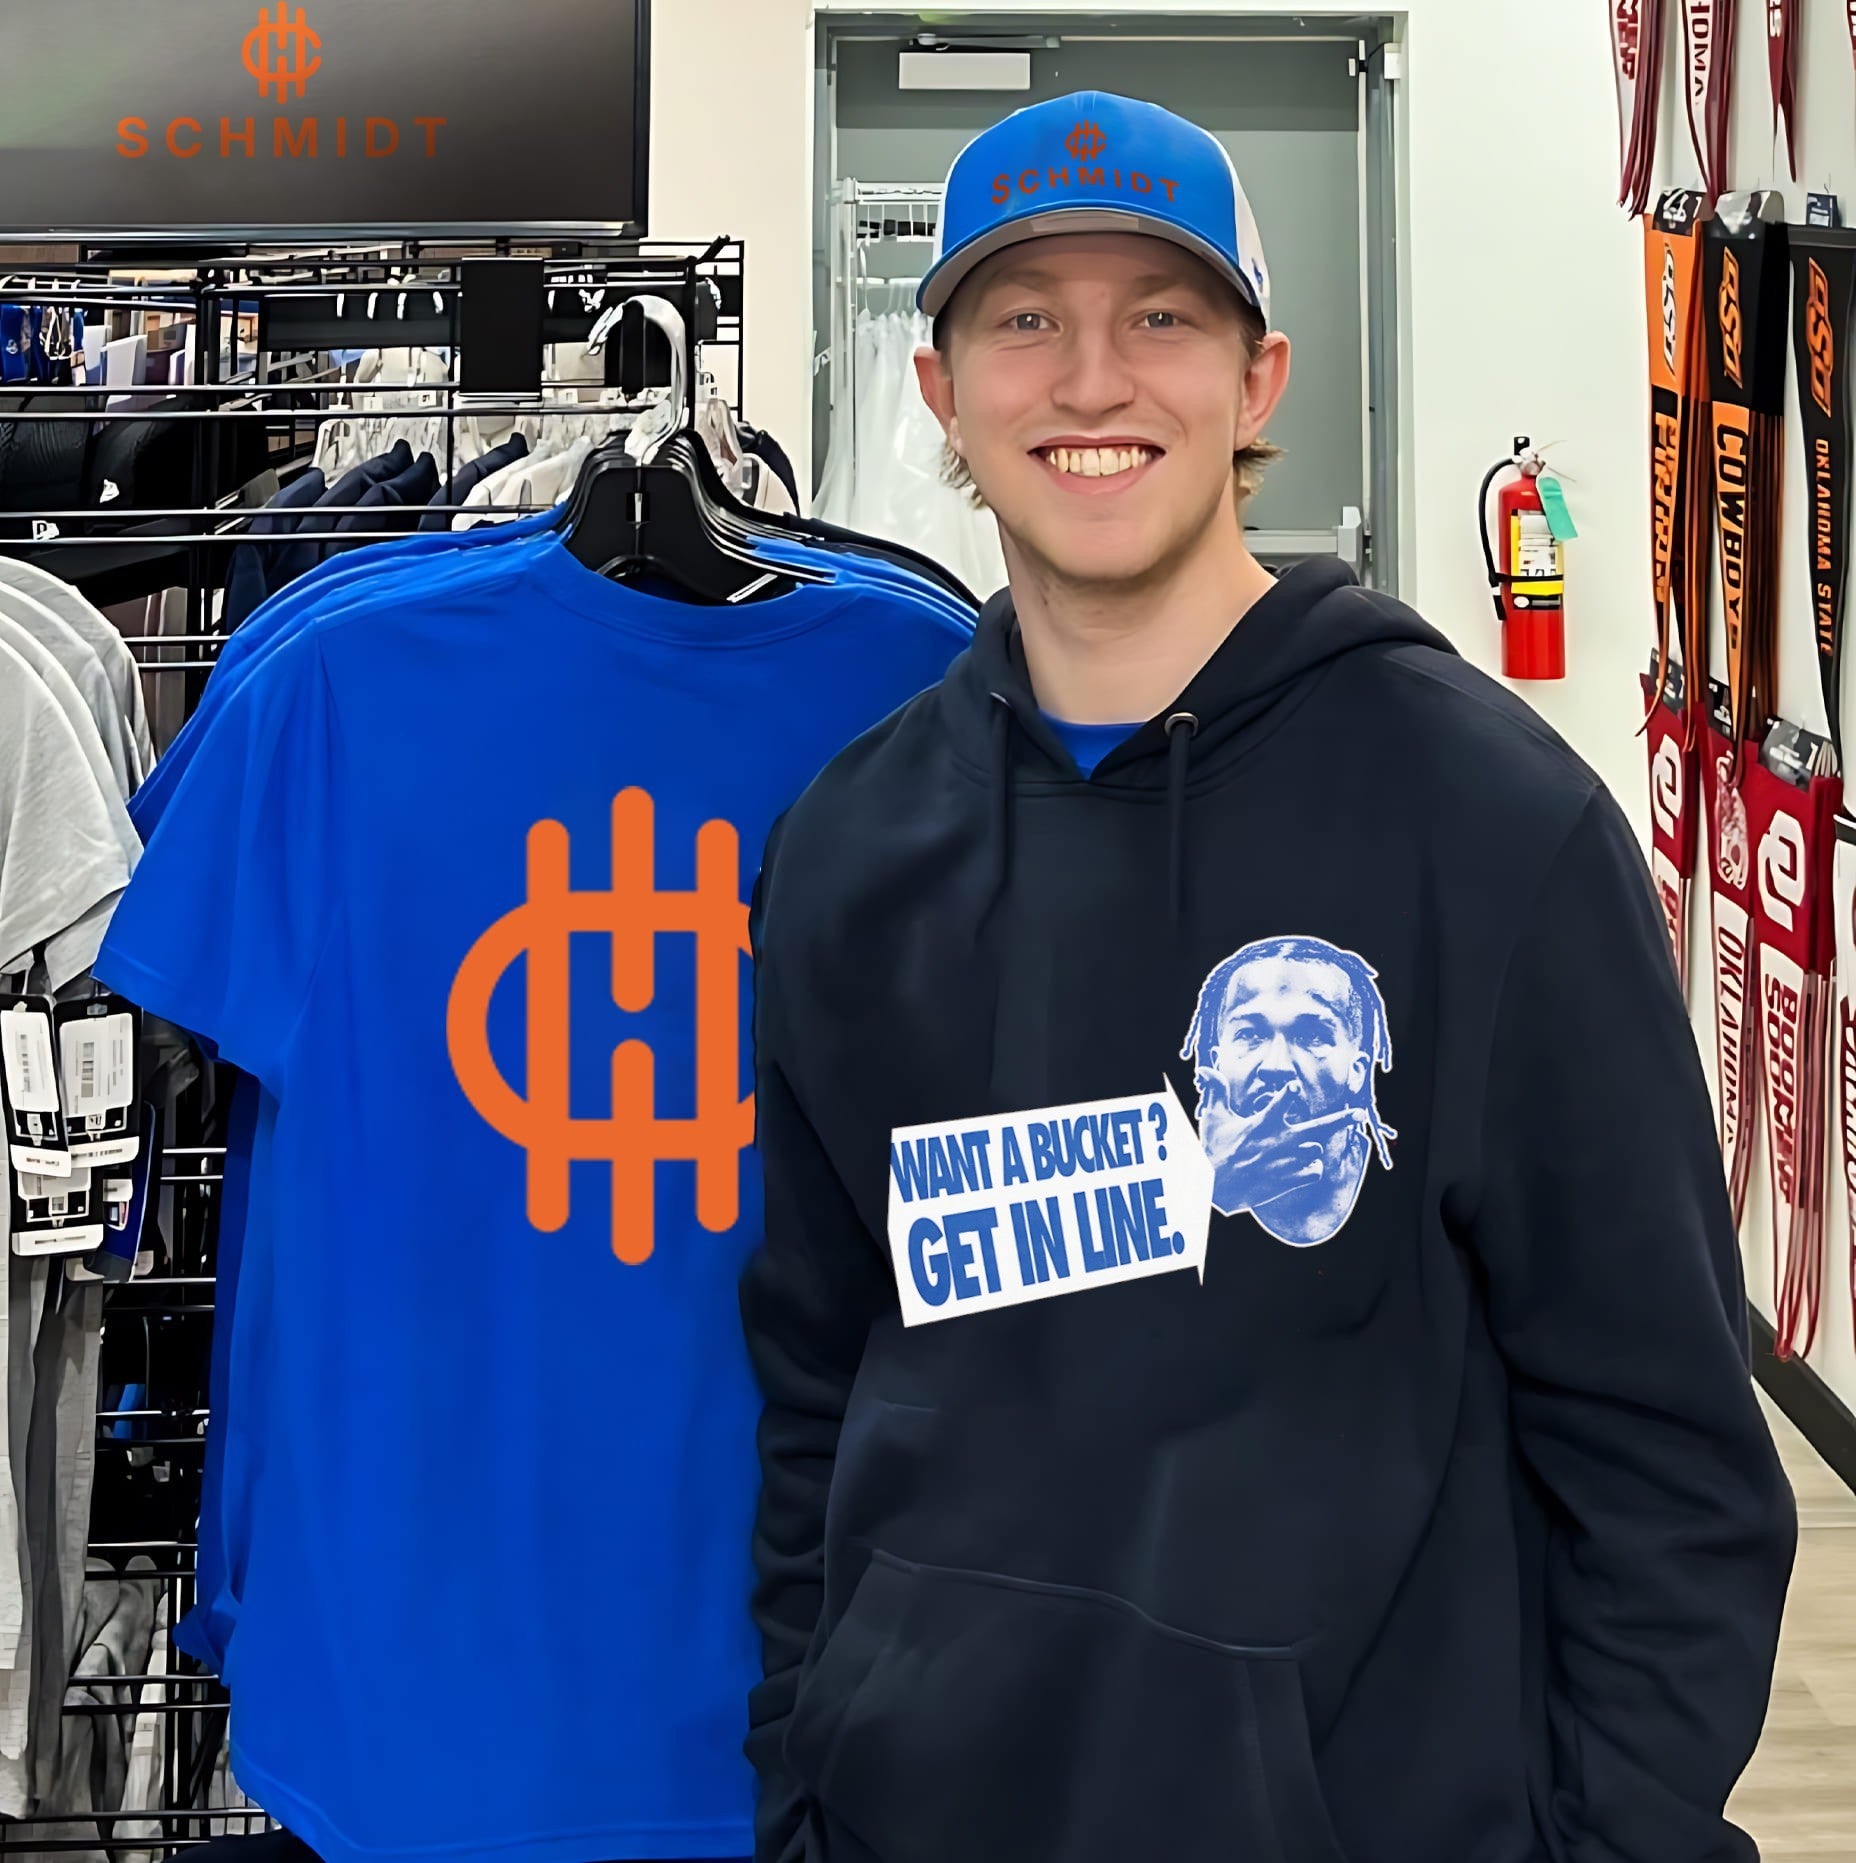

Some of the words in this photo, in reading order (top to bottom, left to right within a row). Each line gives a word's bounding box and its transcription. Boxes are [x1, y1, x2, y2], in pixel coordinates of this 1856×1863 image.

[115, 117, 447, 159] SCHMIDT
[991, 167, 1180, 204] SCHMIDT
[1816, 438, 1832, 569] OKLAHOMA
[891, 1130, 992, 1203] WANT
[1002, 1126, 1028, 1186] A
[908, 1207, 1002, 1307] GET
[1010, 1196, 1070, 1287] IN
[1073, 1178, 1185, 1273] LINE.
